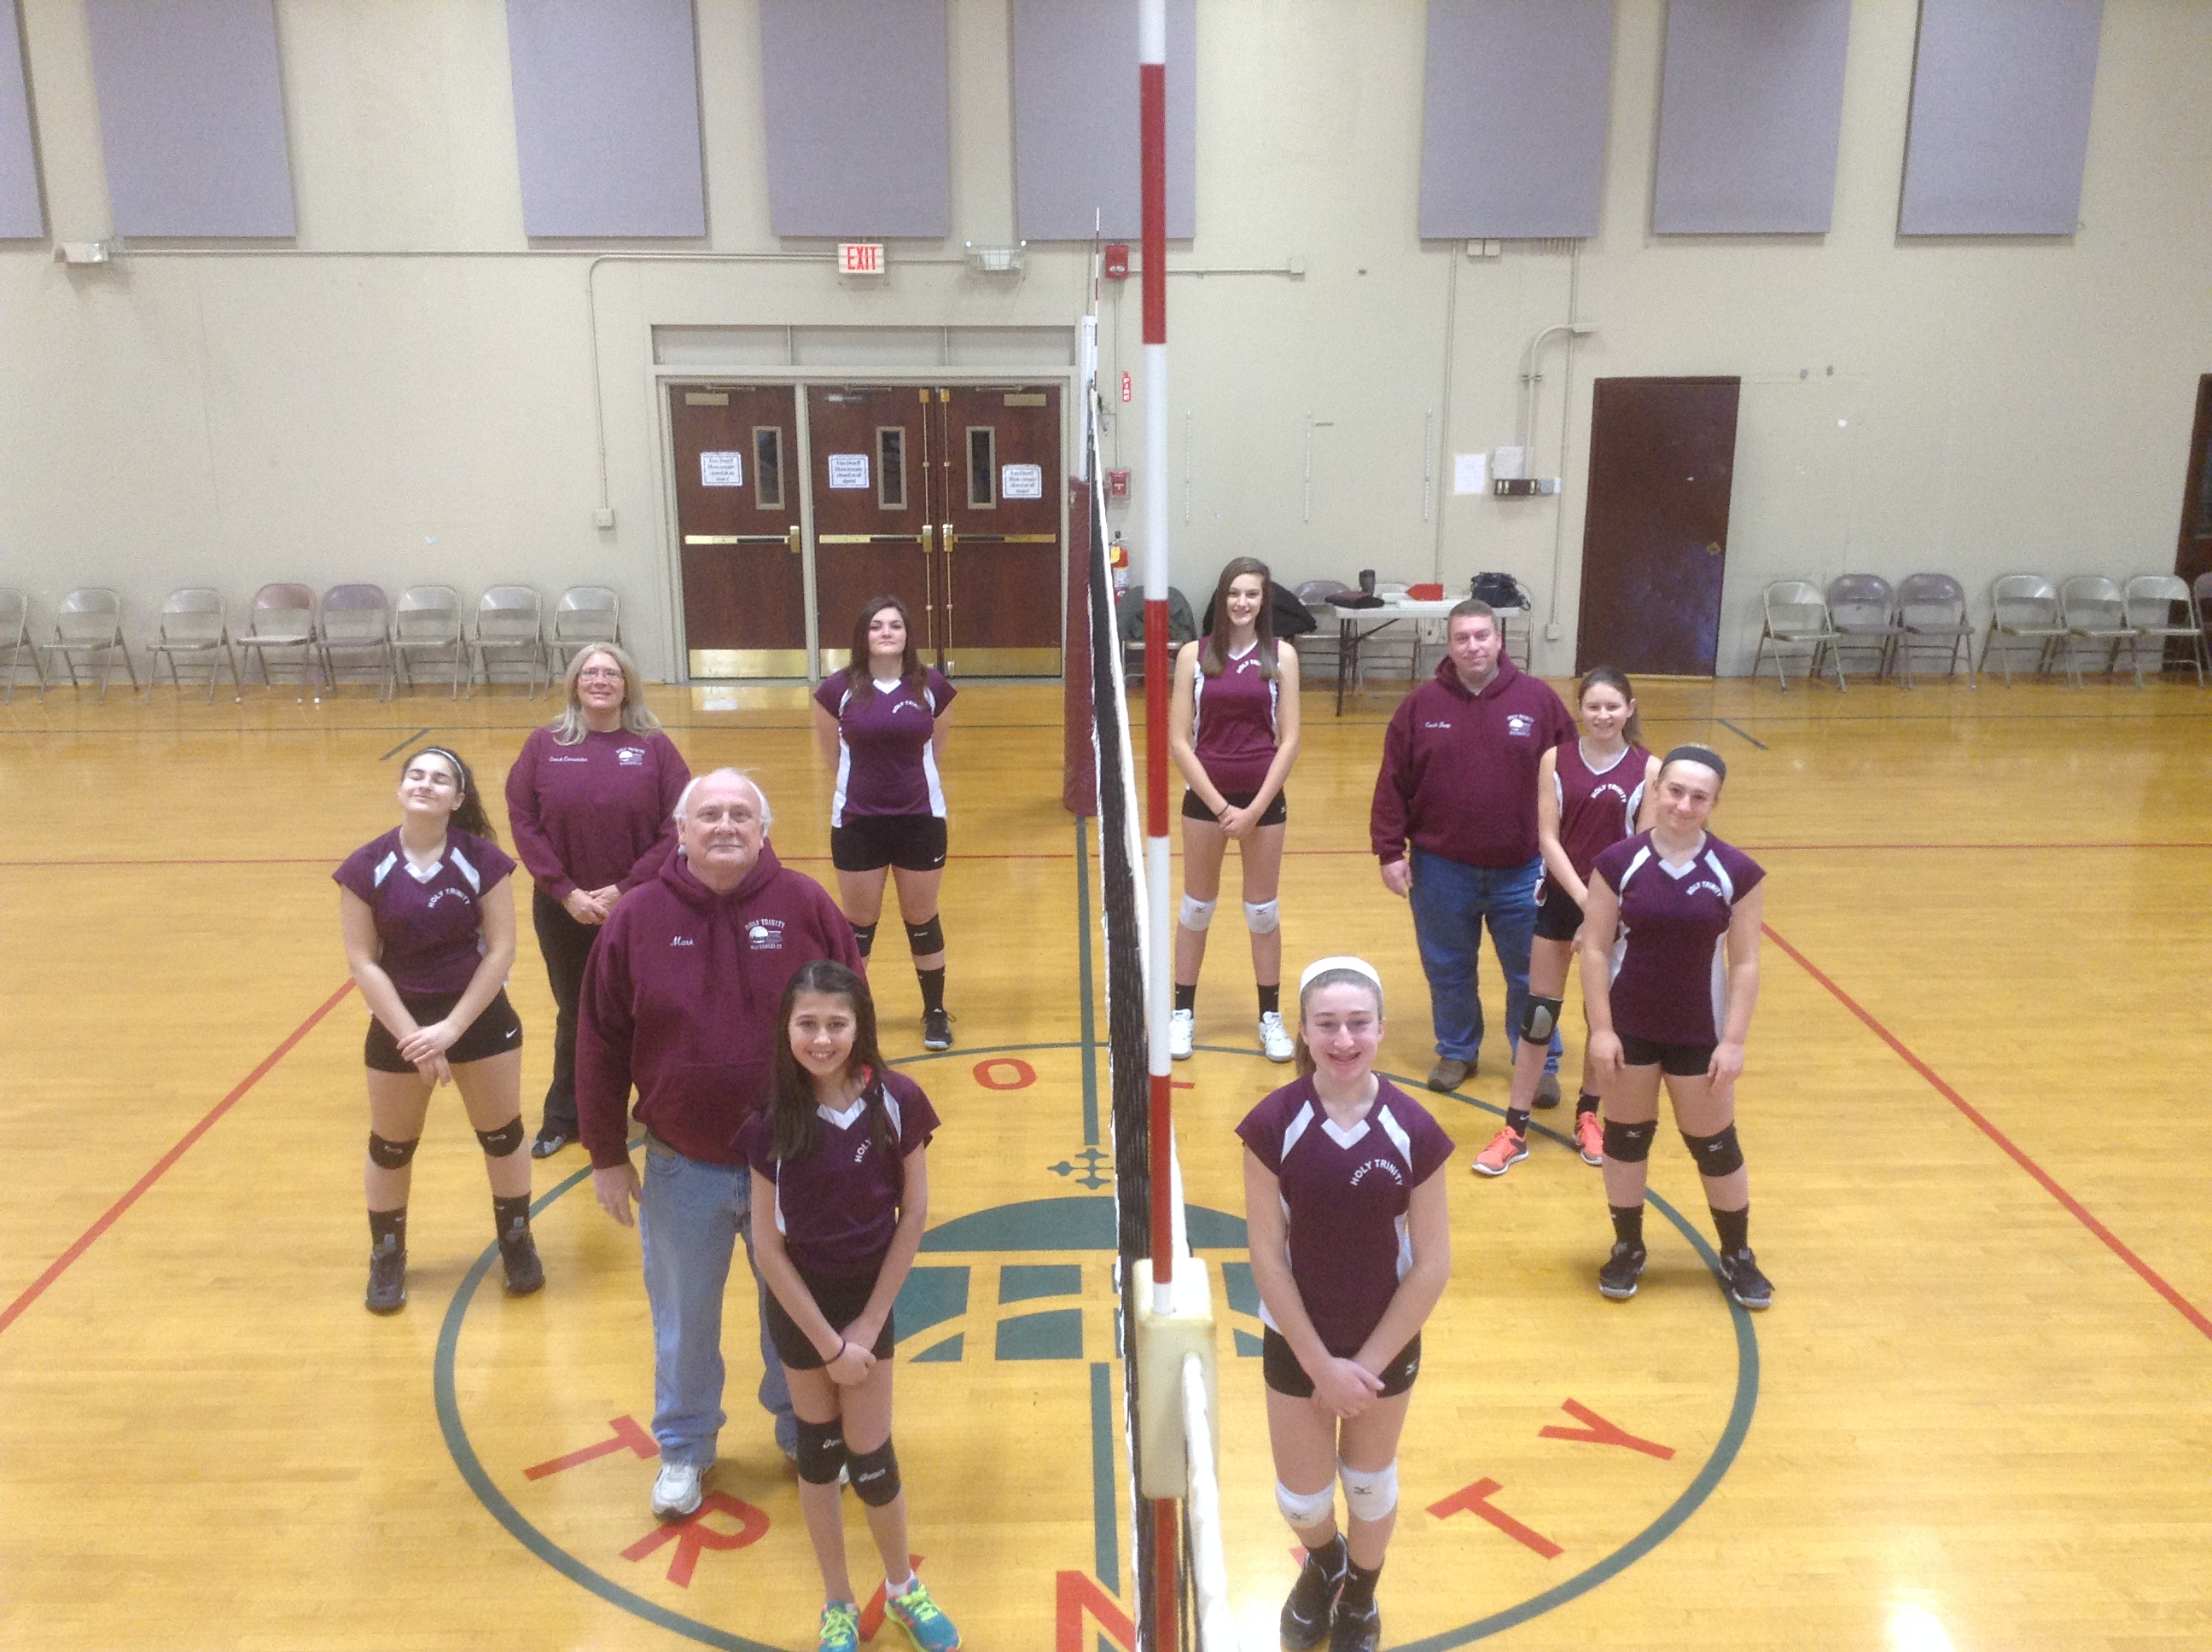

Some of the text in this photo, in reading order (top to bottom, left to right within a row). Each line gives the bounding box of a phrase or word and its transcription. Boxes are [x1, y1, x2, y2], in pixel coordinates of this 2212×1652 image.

[847, 246, 878, 270] EXIT
[428, 890, 444, 909] HOLY
[854, 1137, 871, 1163] HOLY
[1349, 1159, 1403, 1186] HOLY TRINITY
